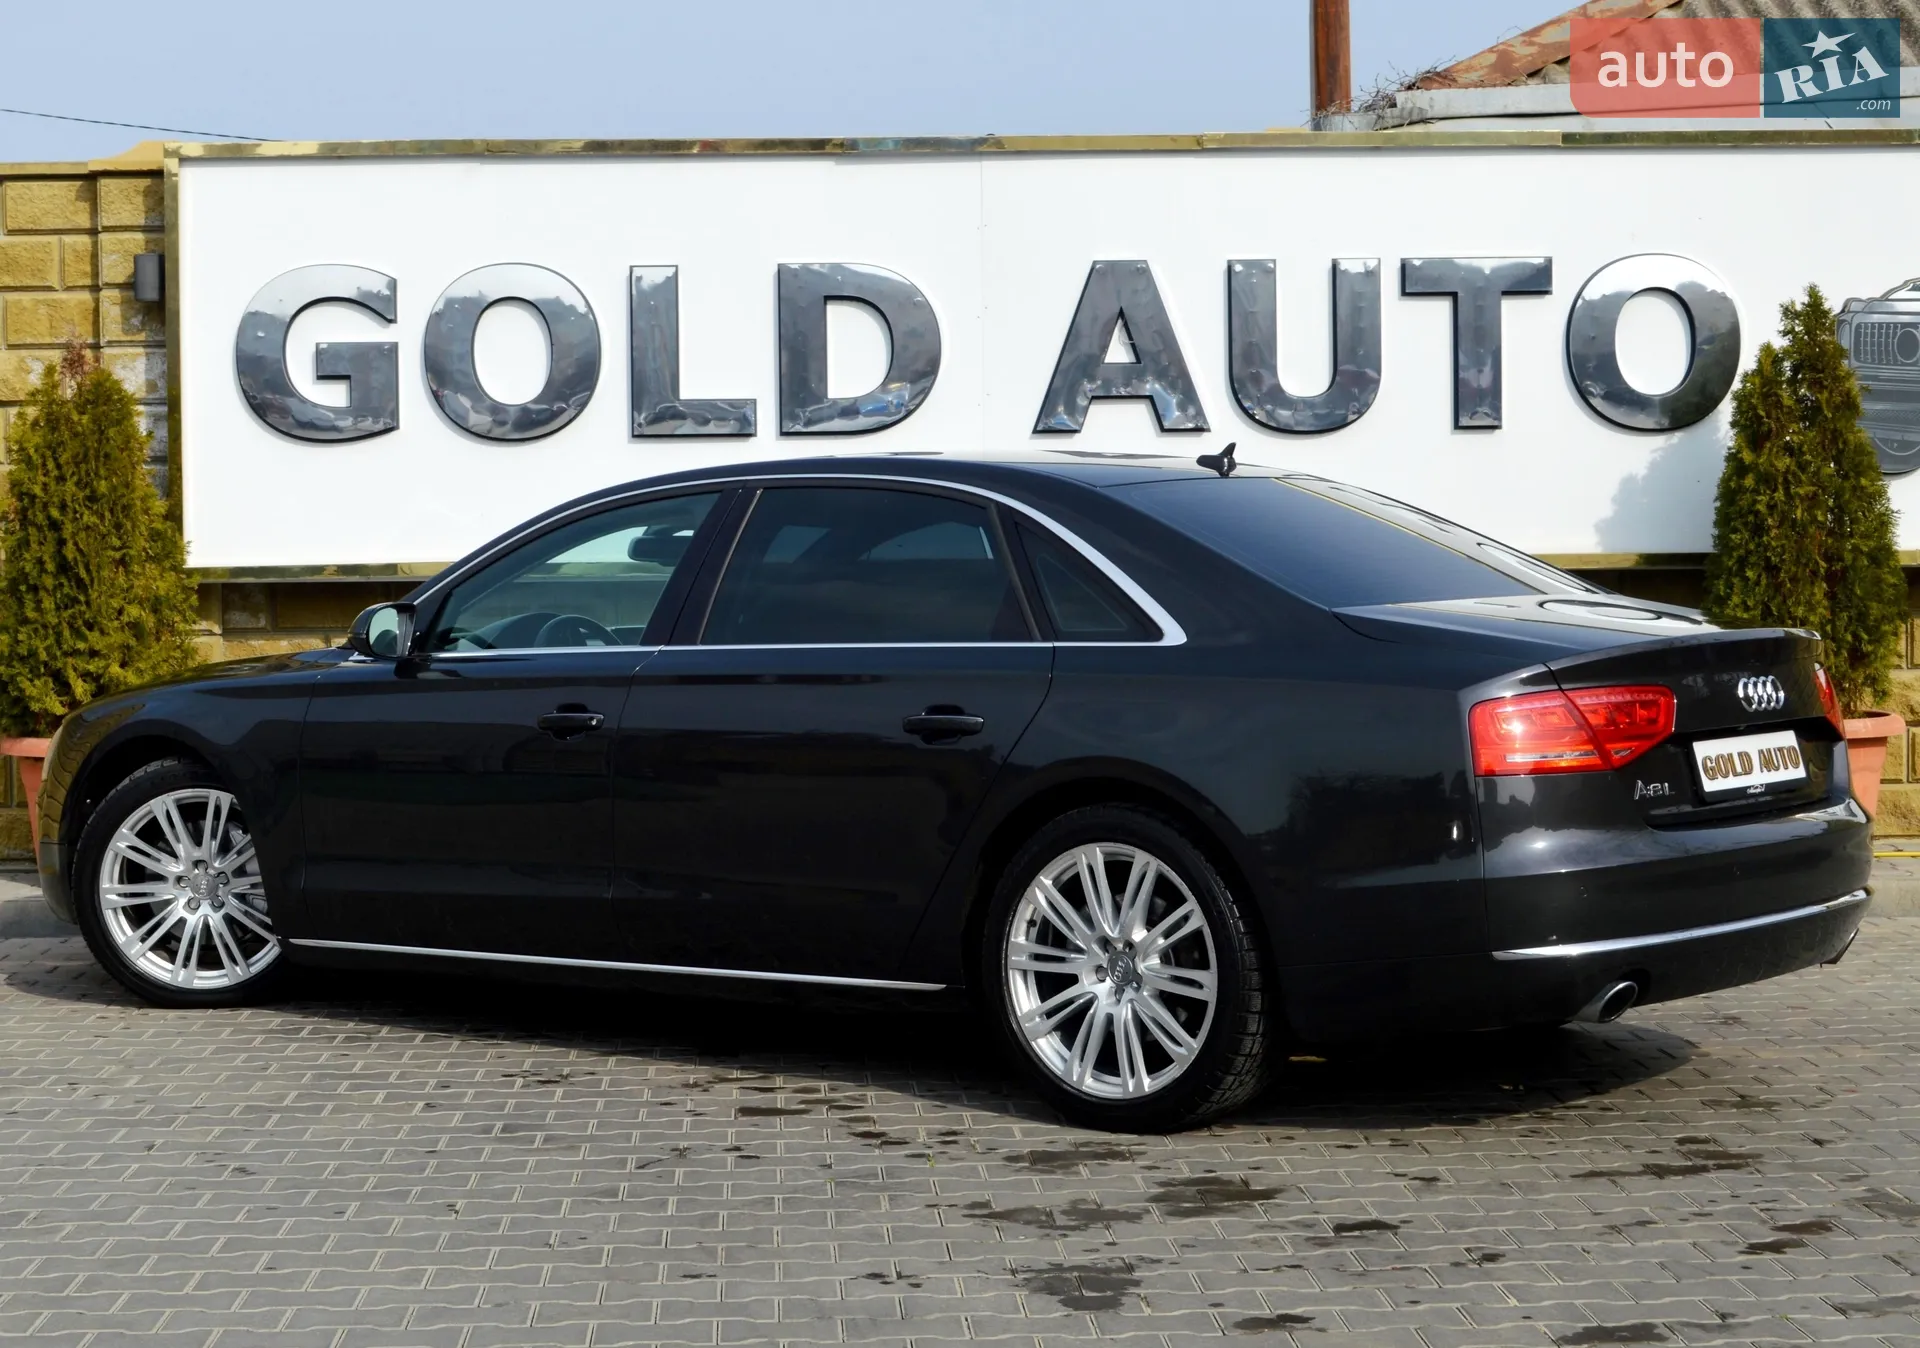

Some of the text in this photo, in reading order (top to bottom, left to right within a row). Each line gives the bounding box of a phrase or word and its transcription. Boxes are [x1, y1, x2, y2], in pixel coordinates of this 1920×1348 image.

[235, 253, 1742, 443] GOLD AUTO
[1702, 745, 1801, 781] GOLD AUTO
